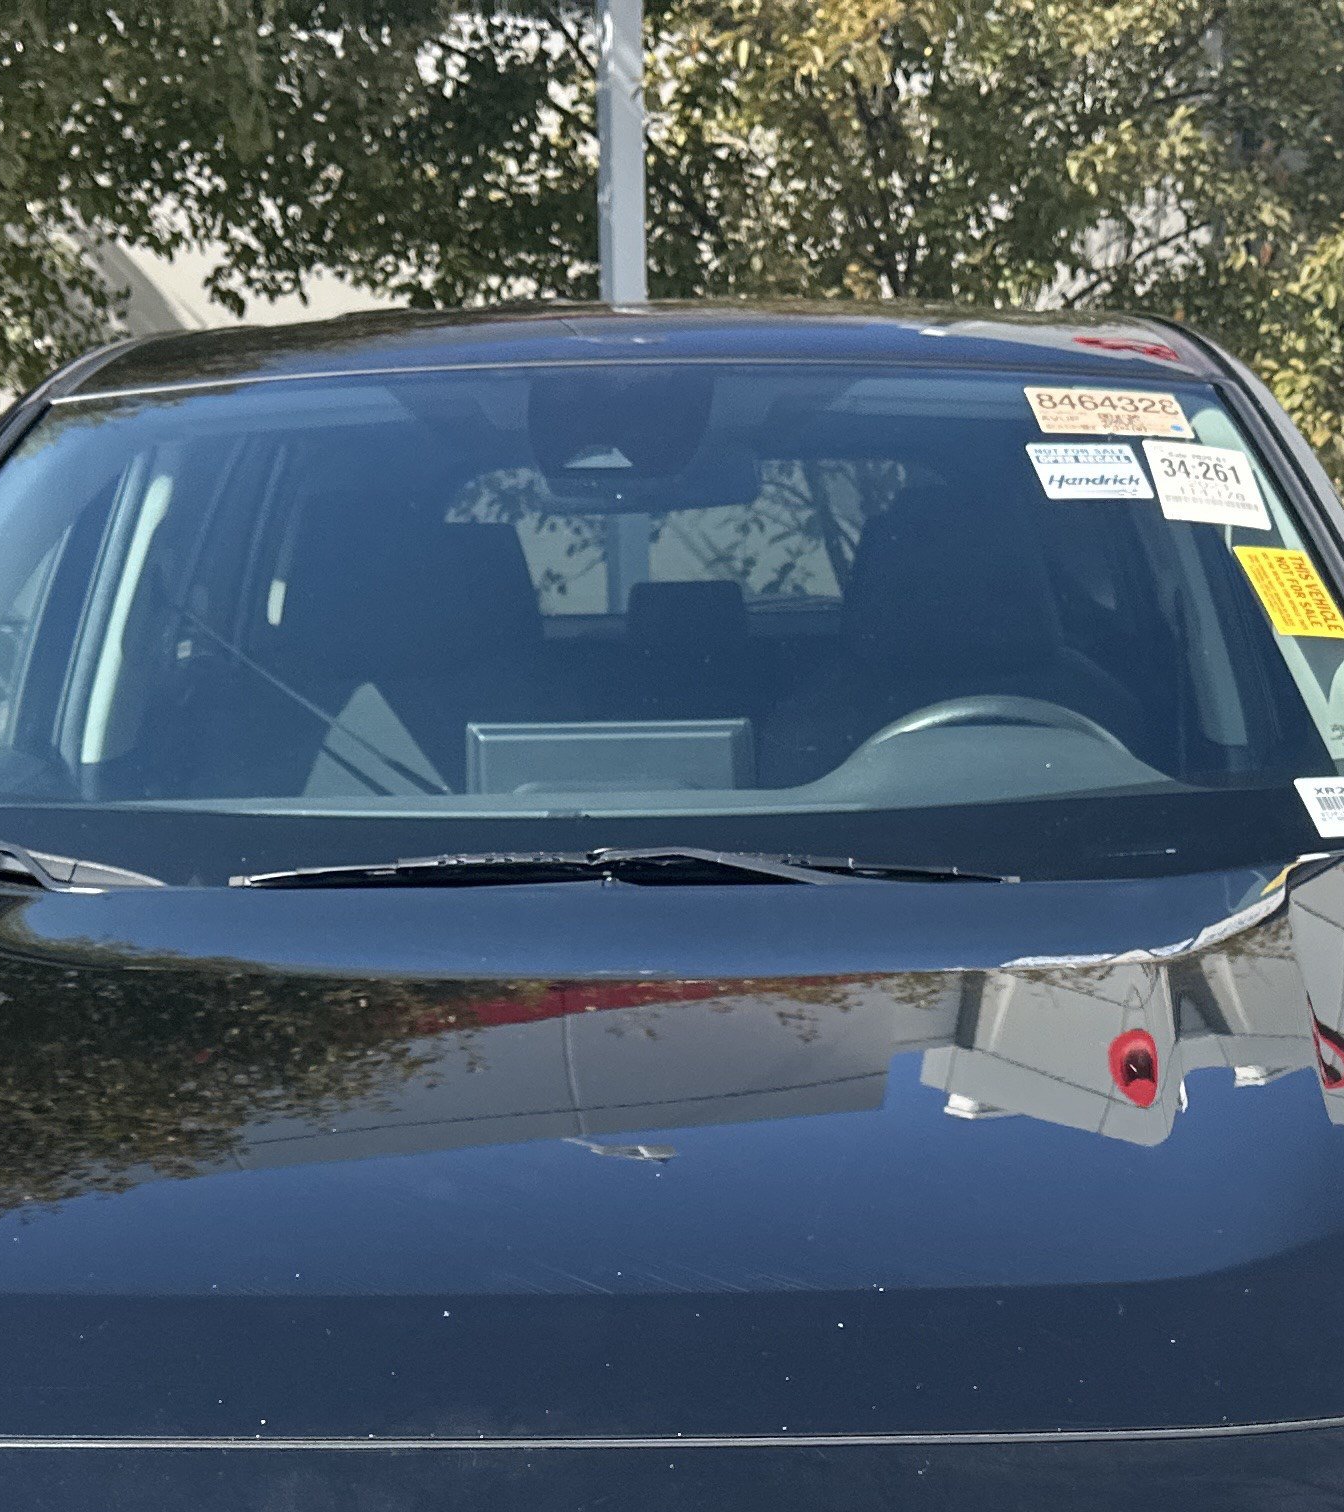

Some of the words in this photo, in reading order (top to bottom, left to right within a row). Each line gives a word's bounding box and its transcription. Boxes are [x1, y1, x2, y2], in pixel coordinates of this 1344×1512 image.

[1035, 392, 1180, 416] 8464328
[1275, 556, 1294, 576] NOT
[1286, 578, 1307, 599] FOR
[1299, 602, 1323, 628] SALE
[1289, 556, 1315, 580] THIS
[1305, 583, 1344, 632] VEHICLE
